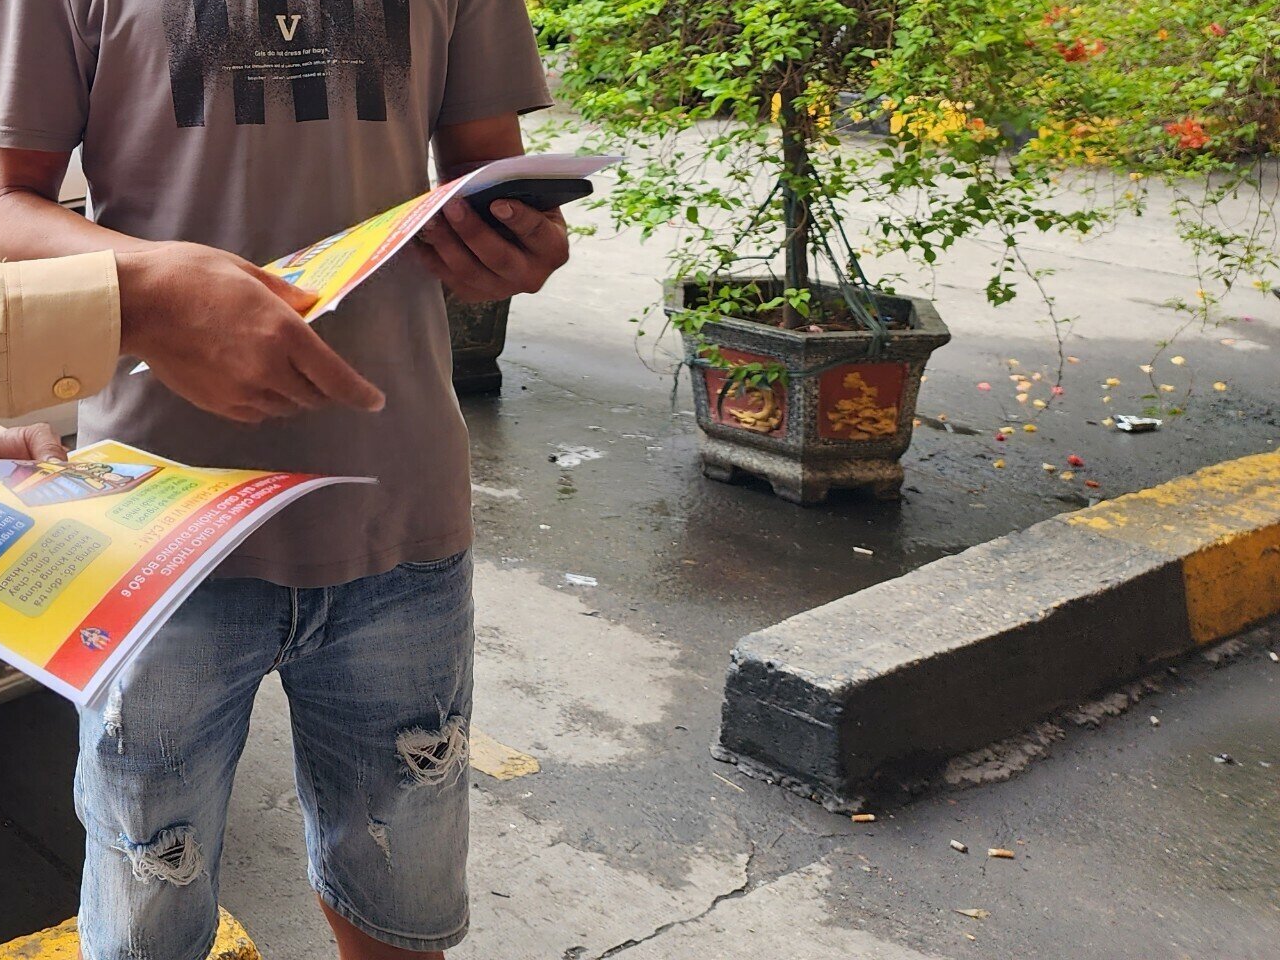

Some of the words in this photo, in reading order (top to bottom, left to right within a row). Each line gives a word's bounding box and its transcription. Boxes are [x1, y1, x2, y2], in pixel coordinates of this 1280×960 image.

[275, 14, 302, 41] V
[190, 527, 215, 545] GIAO
[120, 589, 132, 597] 6
